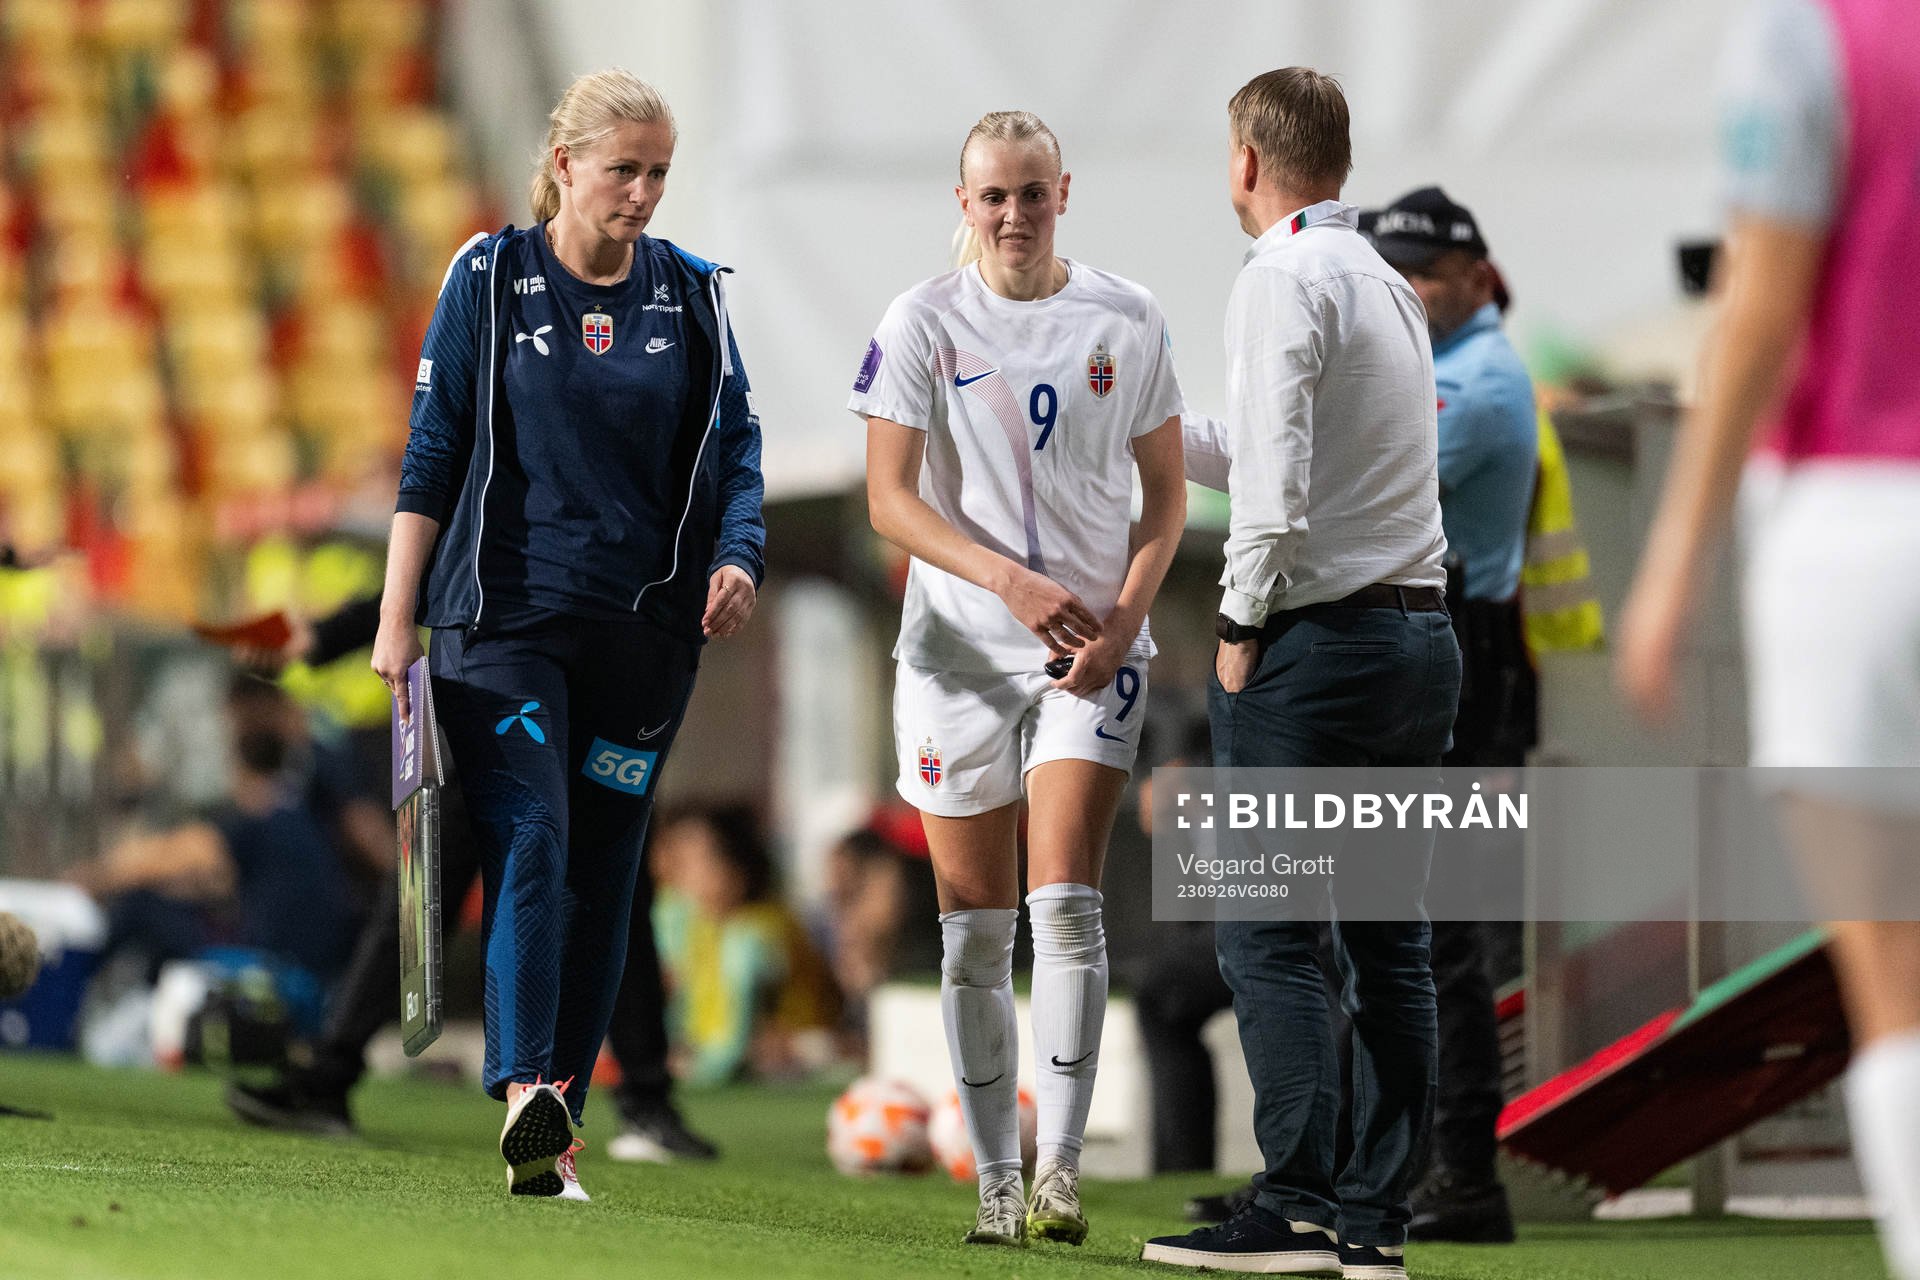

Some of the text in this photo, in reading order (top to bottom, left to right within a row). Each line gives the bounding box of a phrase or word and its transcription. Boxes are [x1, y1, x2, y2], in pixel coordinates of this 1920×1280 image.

[650, 337, 668, 348] NIKE
[1029, 383, 1058, 451] 9
[1115, 666, 1141, 723] 9
[591, 749, 648, 786] 5G
